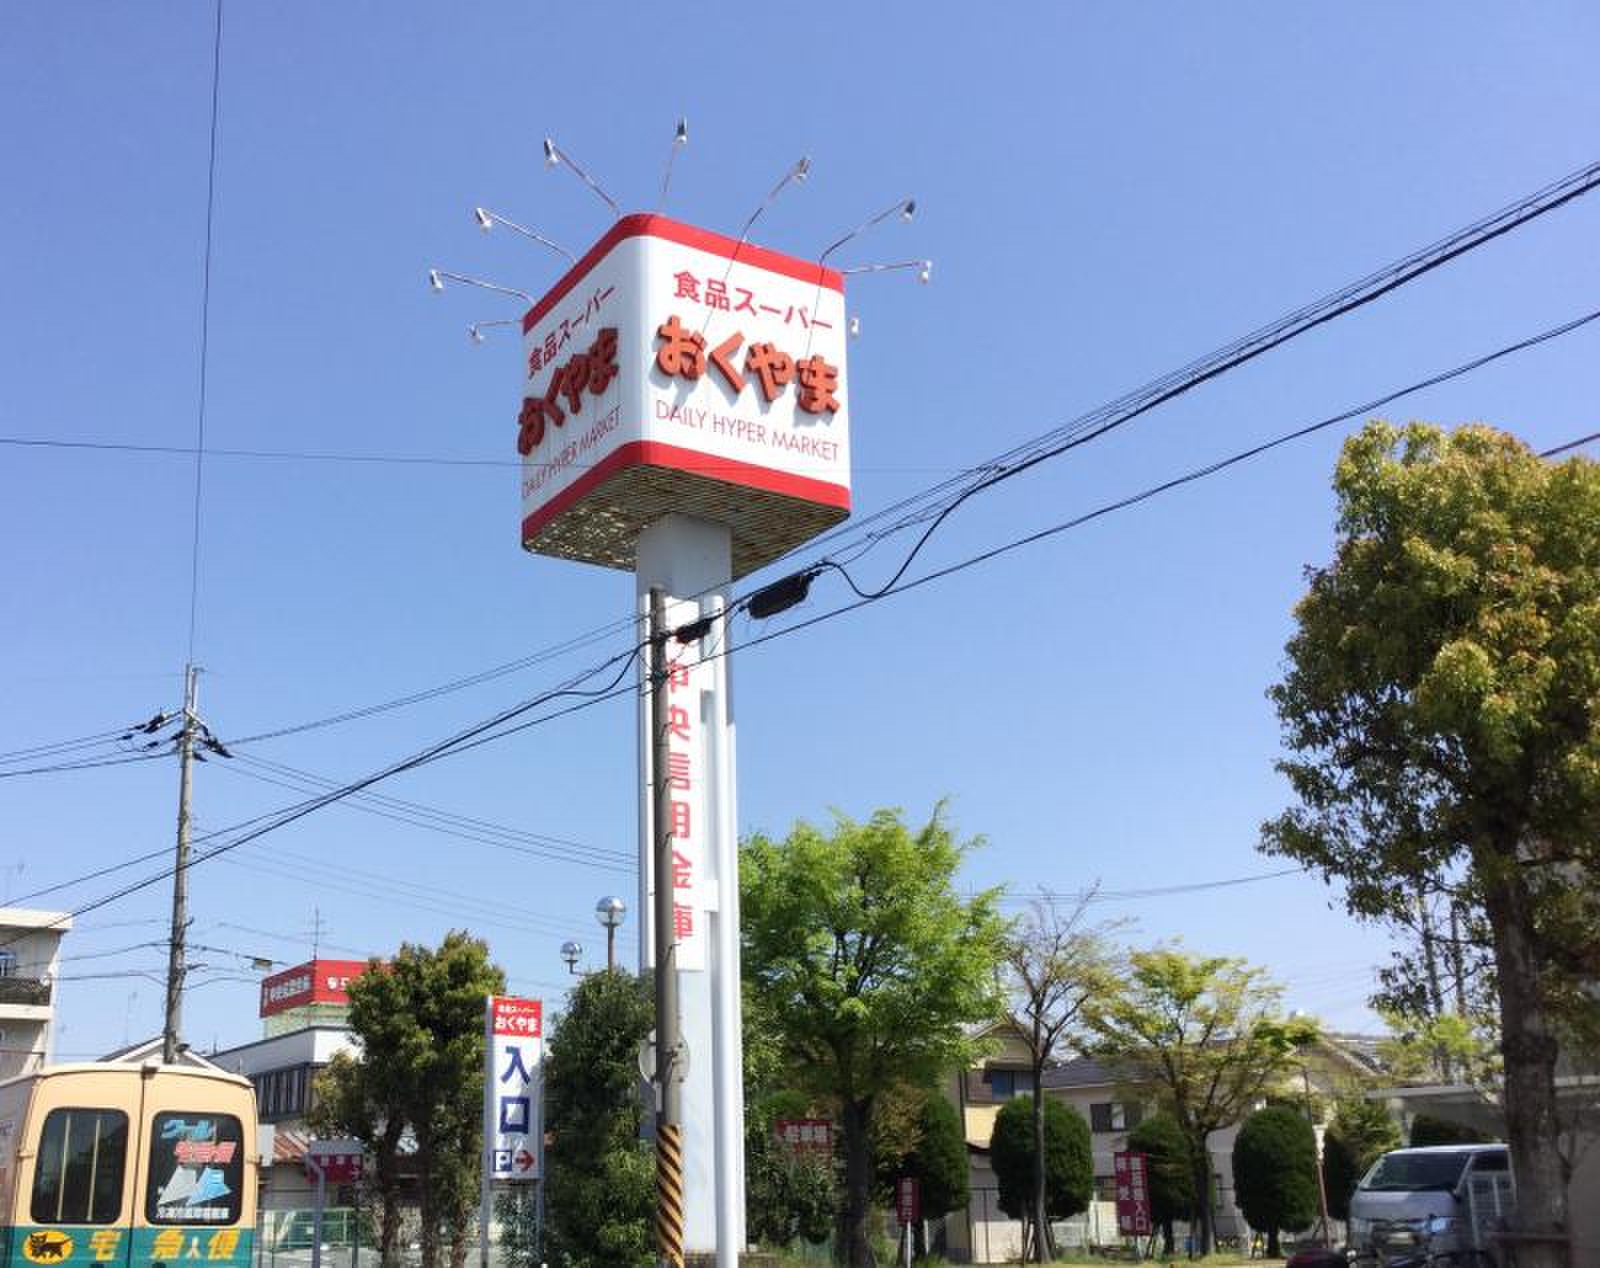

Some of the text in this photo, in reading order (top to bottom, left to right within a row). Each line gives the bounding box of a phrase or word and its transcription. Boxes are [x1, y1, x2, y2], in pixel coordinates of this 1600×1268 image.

[528, 285, 615, 379] 食品スーパー
[673, 270, 833, 330] 食品スーパー
[518, 327, 620, 456] おくやま
[656, 314, 840, 416] おくやま
[578, 405, 621, 455] MARKET
[656, 399, 839, 462] DAILY HYPER MARKET
[495, 1015, 539, 1033] おくやま
[501, 1045, 532, 1134] 入口
